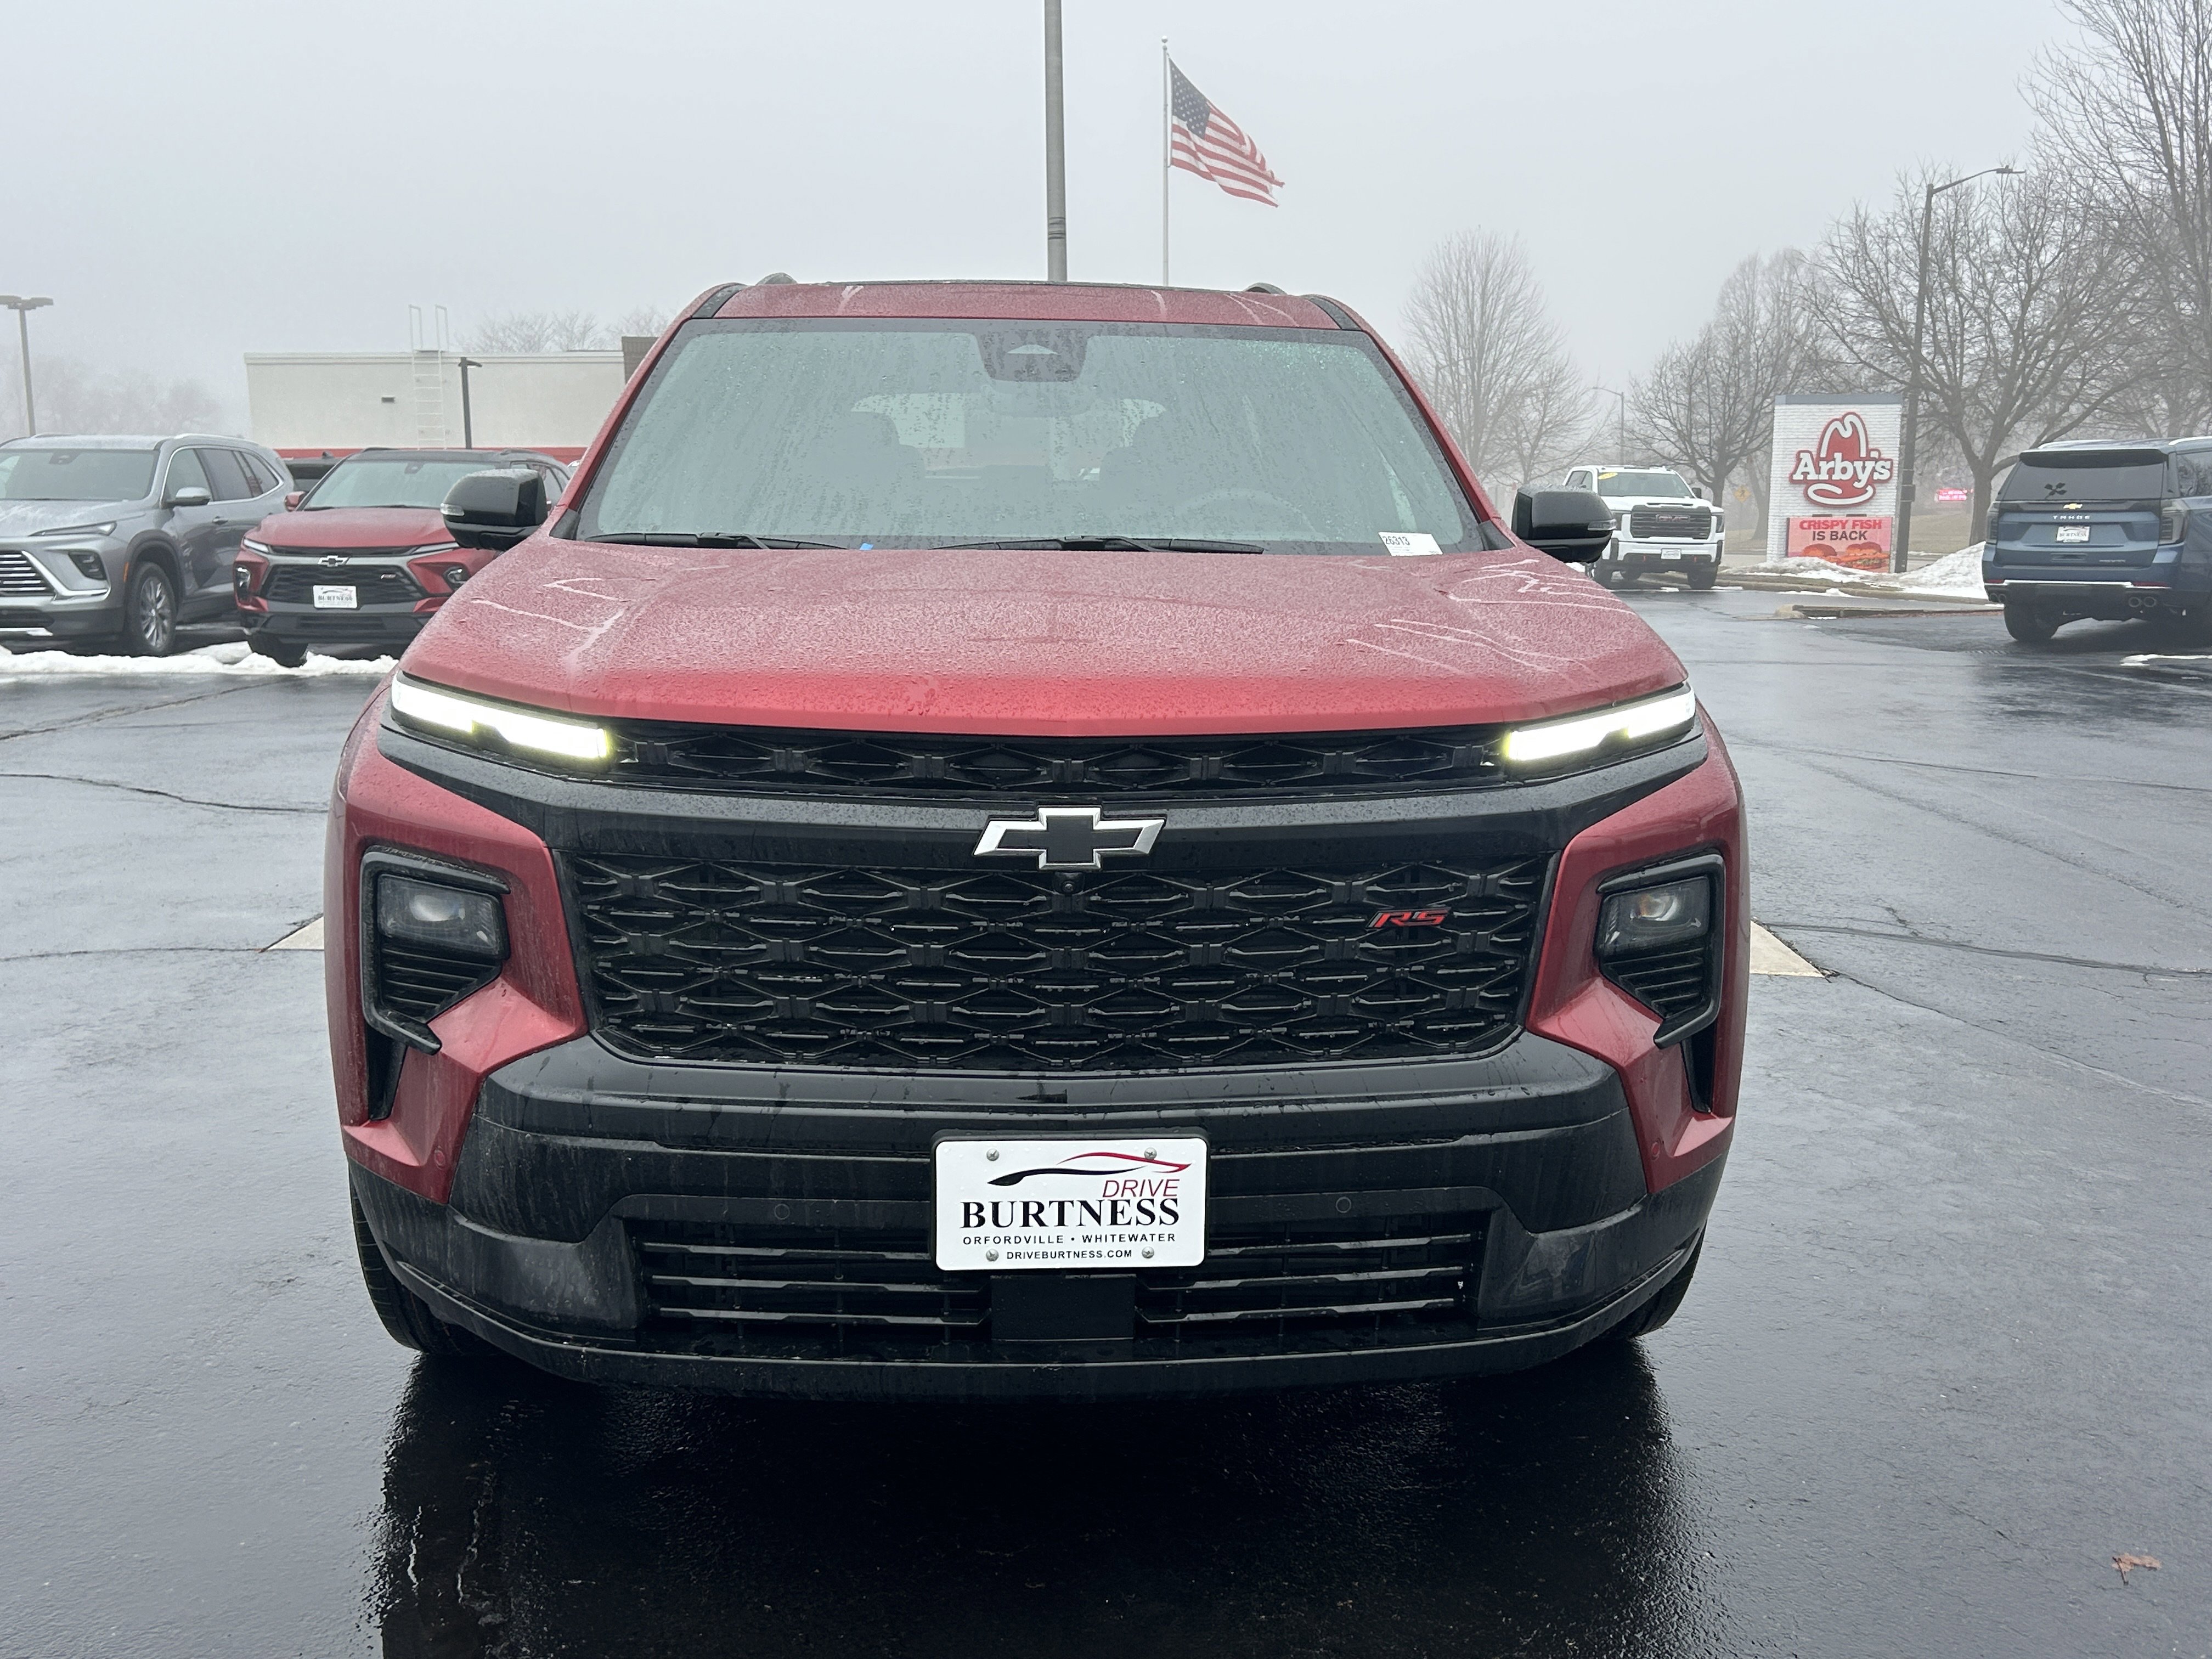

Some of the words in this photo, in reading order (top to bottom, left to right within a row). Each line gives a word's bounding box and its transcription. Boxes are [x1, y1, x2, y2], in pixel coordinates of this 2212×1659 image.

[1792, 451, 1891, 488] Arby's
[1799, 520, 1849, 530] CRISPY
[1852, 519, 1882, 529] FISH
[1383, 536, 1410, 545] 26313
[1813, 531, 1826, 541] IS
[1830, 530, 1868, 541] BACK
[1368, 909, 1449, 928] RS
[1102, 1178, 1180, 1198] DRIVE
[960, 1198, 1179, 1228] BURTNESS
[963, 1235, 1064, 1245] ORFORDVILLE
[1082, 1233, 1175, 1243] WHITEWATER
[1007, 1250, 1132, 1260] DRIVEBURTNESS.COM
